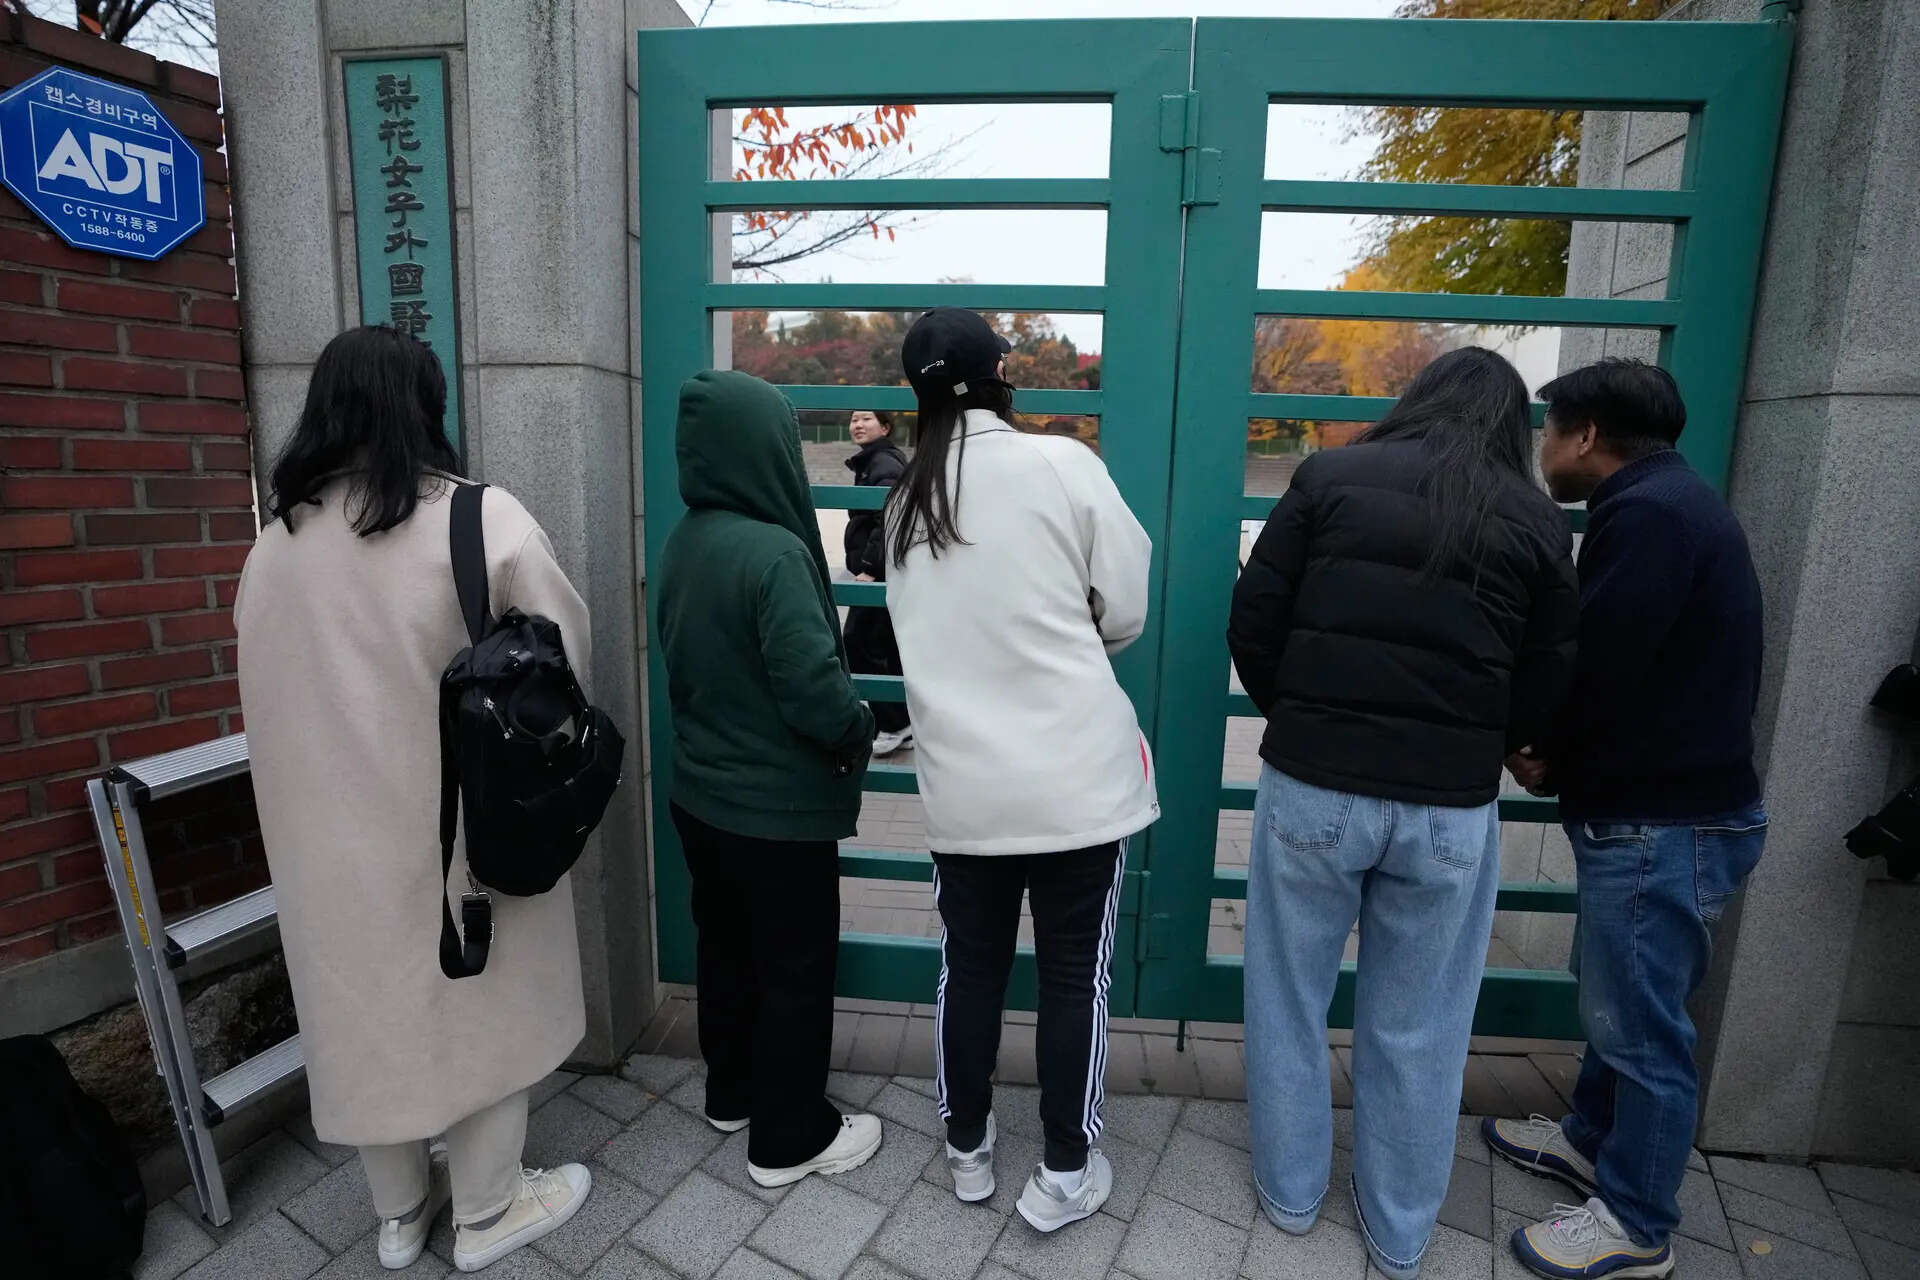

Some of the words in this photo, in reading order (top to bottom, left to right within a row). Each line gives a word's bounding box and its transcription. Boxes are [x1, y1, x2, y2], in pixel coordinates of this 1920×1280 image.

[80, 222, 145, 243] 1588-6400
[376, 73, 432, 346] 梨花女子外國語
